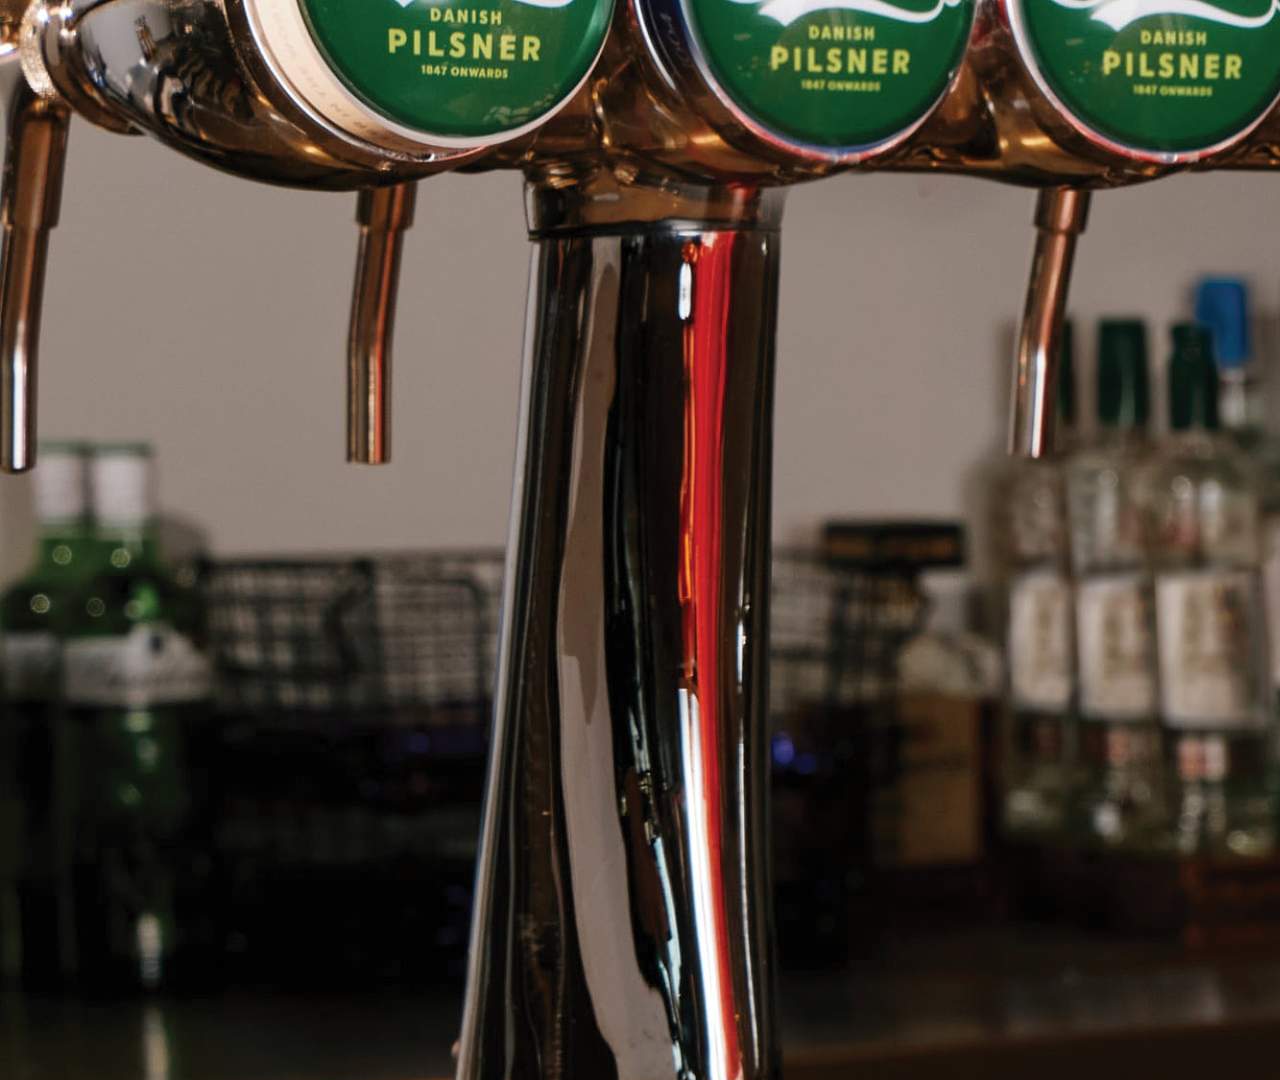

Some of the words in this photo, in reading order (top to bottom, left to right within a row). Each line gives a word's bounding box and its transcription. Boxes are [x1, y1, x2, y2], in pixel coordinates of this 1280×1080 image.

[430, 7, 502, 26] DANISH
[808, 25, 874, 41] DANISH
[1140, 30, 1207, 46] DANISH
[388, 28, 541, 62] PILSNER
[770, 46, 910, 74] PILSNER
[1102, 51, 1243, 79] PILSNER
[421, 64, 447, 77] 1847
[451, 66, 509, 79] ONWARDS
[801, 79, 826, 91] 1847
[827, 80, 881, 92] ONWARDS
[1134, 84, 1157, 96] 1847
[1160, 85, 1213, 97] ONWARDS
